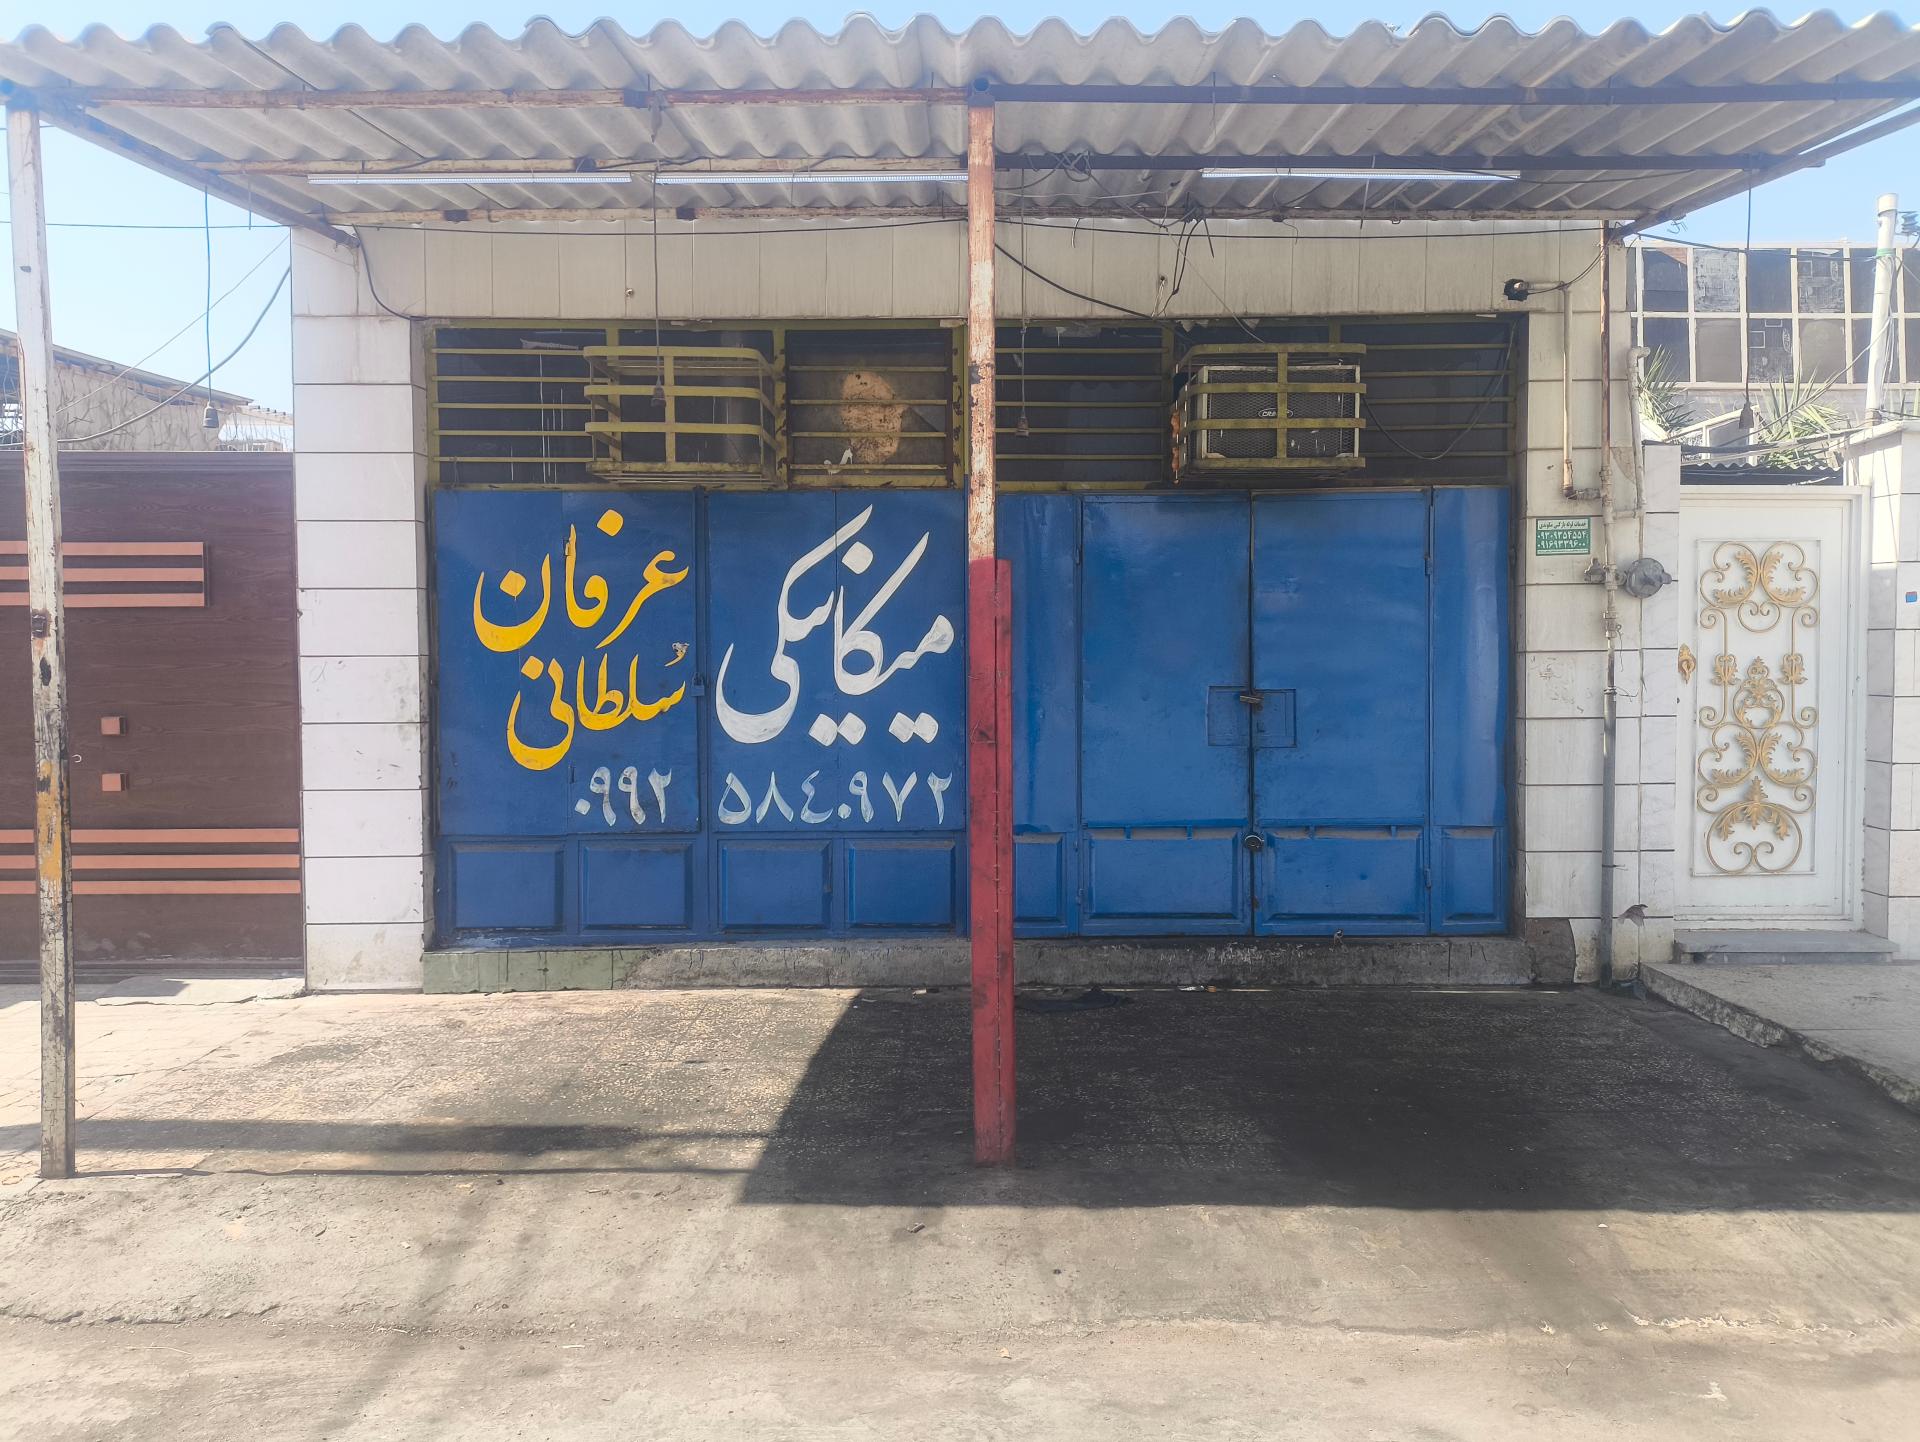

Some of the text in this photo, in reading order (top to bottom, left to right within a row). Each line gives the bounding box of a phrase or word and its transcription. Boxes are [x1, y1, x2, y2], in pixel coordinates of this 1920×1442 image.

[473, 508, 689, 653] عرفان
[716, 504, 955, 744] میکانیکی
[574, 766, 672, 825] ۰۹۹۲
